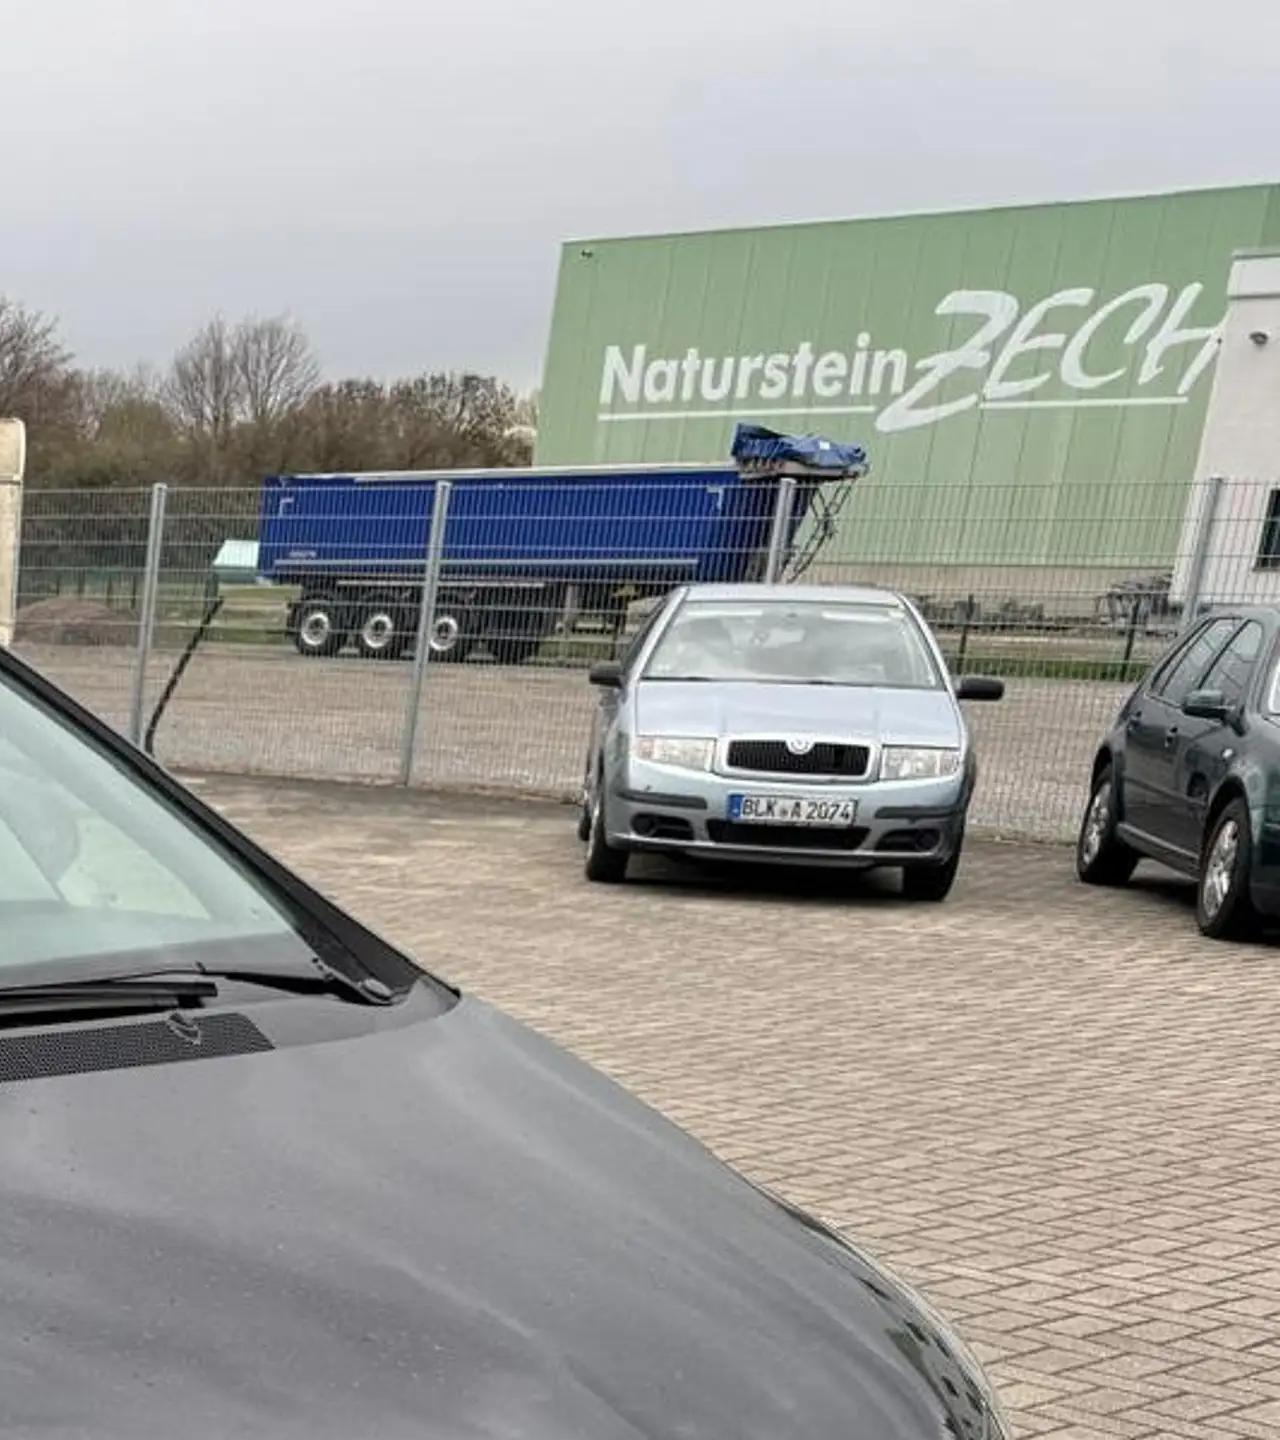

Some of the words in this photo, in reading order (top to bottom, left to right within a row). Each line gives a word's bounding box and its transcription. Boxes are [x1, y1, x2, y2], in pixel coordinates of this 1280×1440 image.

[598, 333, 909, 406] Naturstein
[874, 282, 1226, 433] ZECH
[742, 797, 777, 818] BLK
[790, 801, 802, 819] A
[806, 801, 850, 822] 2074
